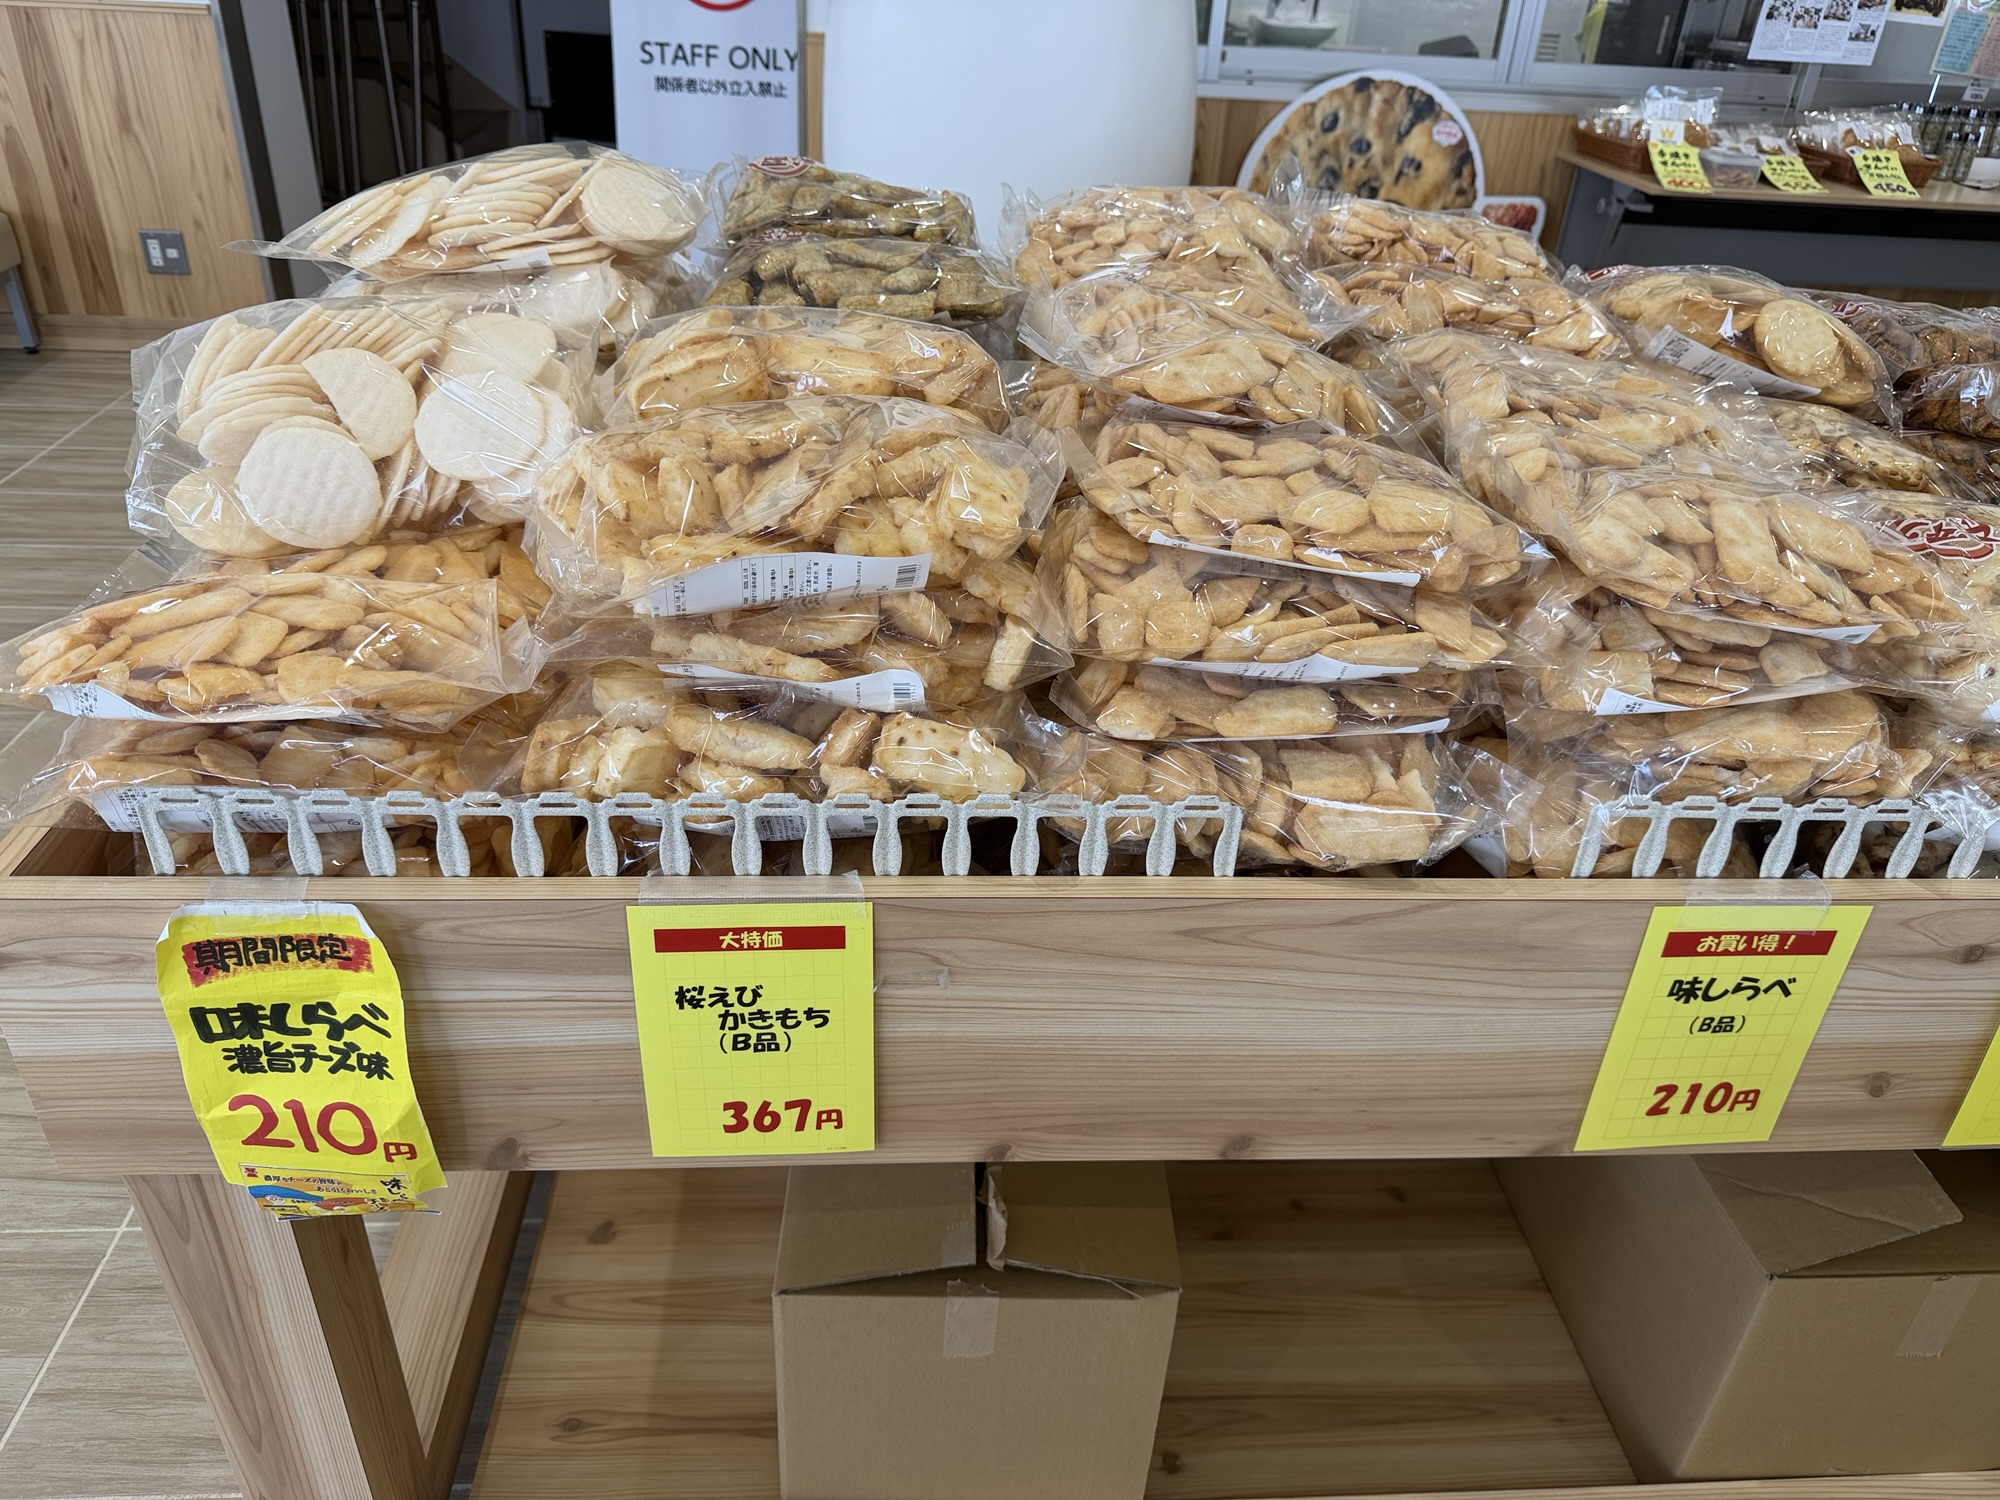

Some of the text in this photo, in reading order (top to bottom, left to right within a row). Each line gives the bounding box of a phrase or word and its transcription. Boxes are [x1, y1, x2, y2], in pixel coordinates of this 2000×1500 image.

[639, 40, 799, 72] STAFF ONLY
[654, 76, 788, 98] 関係者以外立入禁止
[193, 933, 352, 974] 期間限定
[719, 930, 784, 950] 大特価
[1695, 934, 1796, 954] お買い得！
[674, 984, 764, 1010] 桜えび
[1666, 975, 1798, 1005] 味しらべ
[189, 1002, 392, 1044] 味しらべ
[718, 1007, 831, 1031] かきもち
[1688, 1015, 1746, 1035] （B品）
[719, 1031, 793, 1055] （B品）
[220, 1040, 396, 1081] 濃旨チーズ味
[1645, 1080, 1762, 1117] 210円
[227, 1093, 418, 1163] 210円
[722, 1098, 844, 1134] 367円
